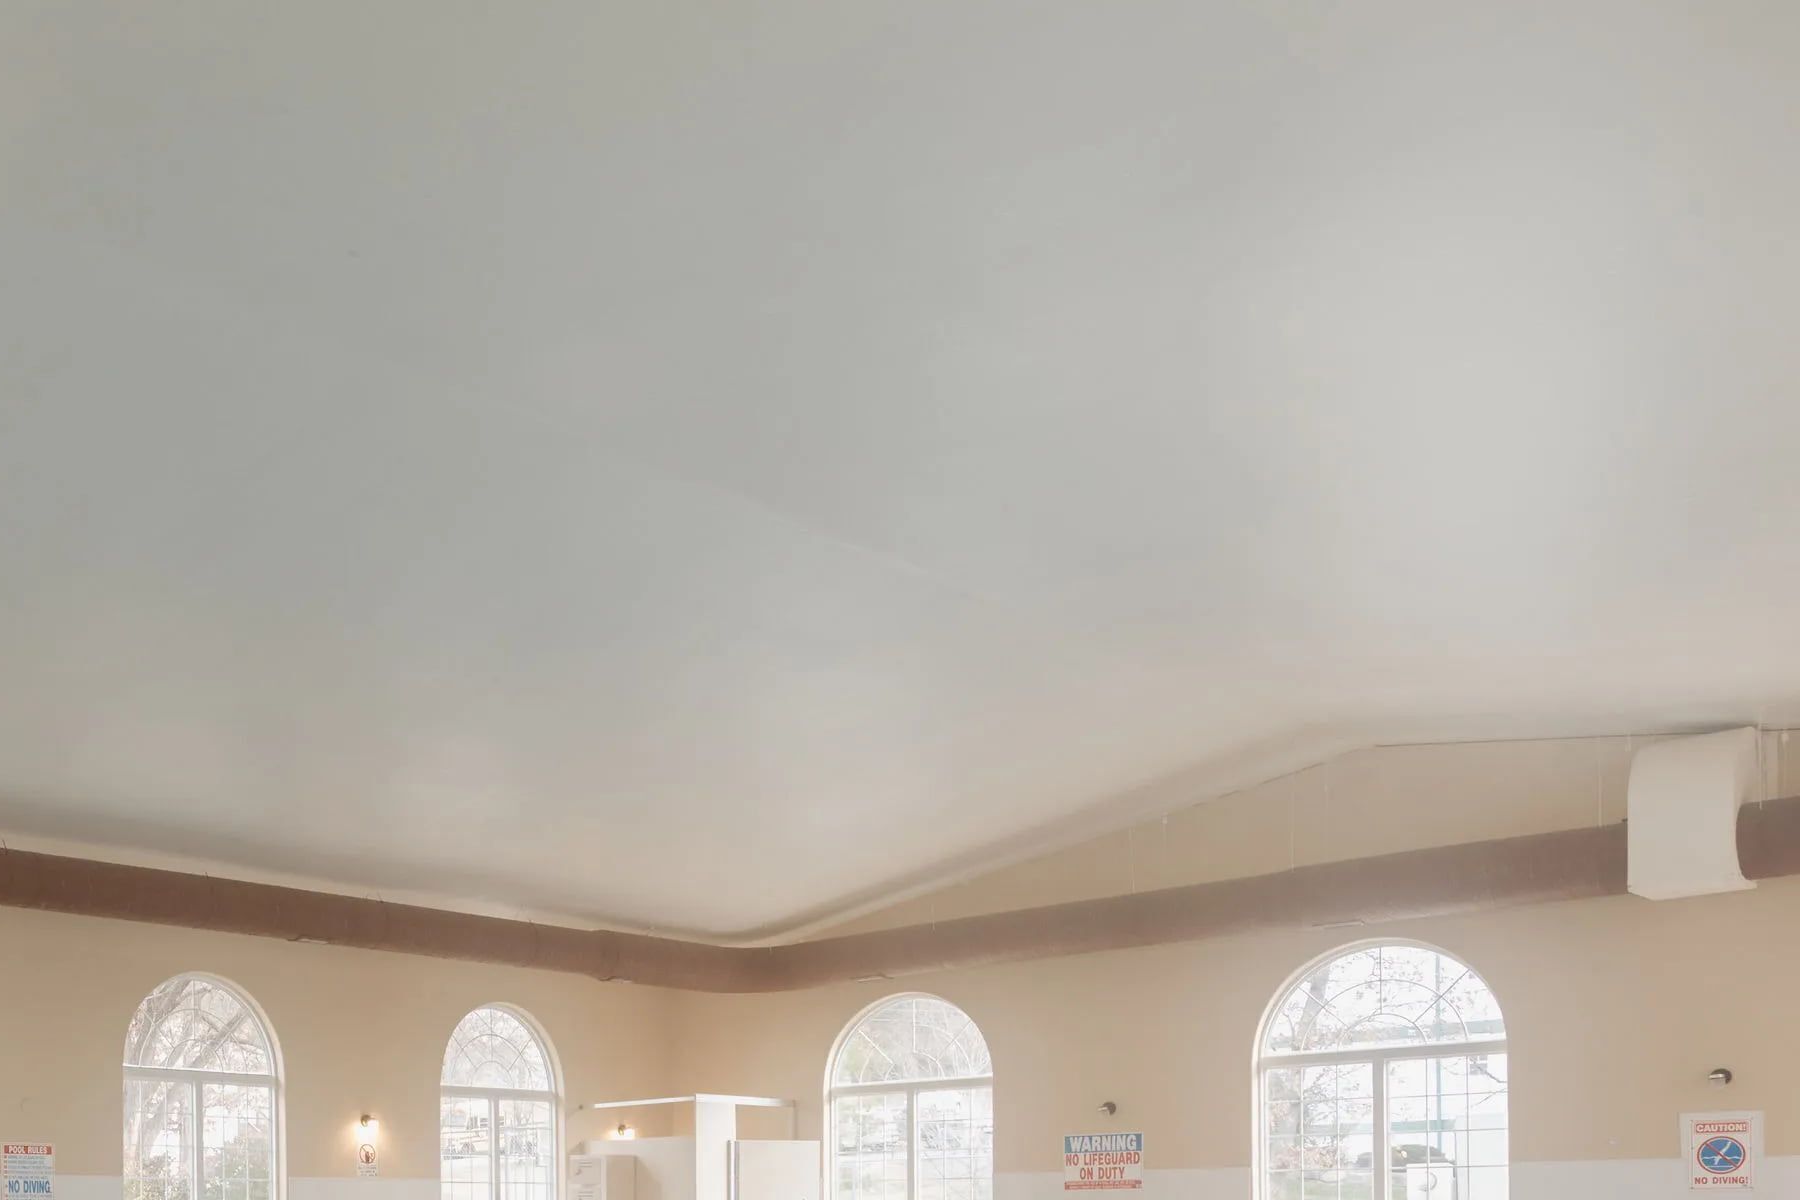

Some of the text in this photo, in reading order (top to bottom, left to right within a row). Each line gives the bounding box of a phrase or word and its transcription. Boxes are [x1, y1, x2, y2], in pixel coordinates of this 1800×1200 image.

[1696, 1123, 1746, 1132] CAUTION!
[9, 1145, 48, 1154] POOL RULES
[1070, 1135, 1136, 1152] WARNING
[1066, 1152, 1140, 1166] NO LIFEGUARD
[1080, 1167, 1125, 1180] ON DUTY
[1712, 1176, 1748, 1184] DIVING!
[8, 1180, 20, 1194] NO
